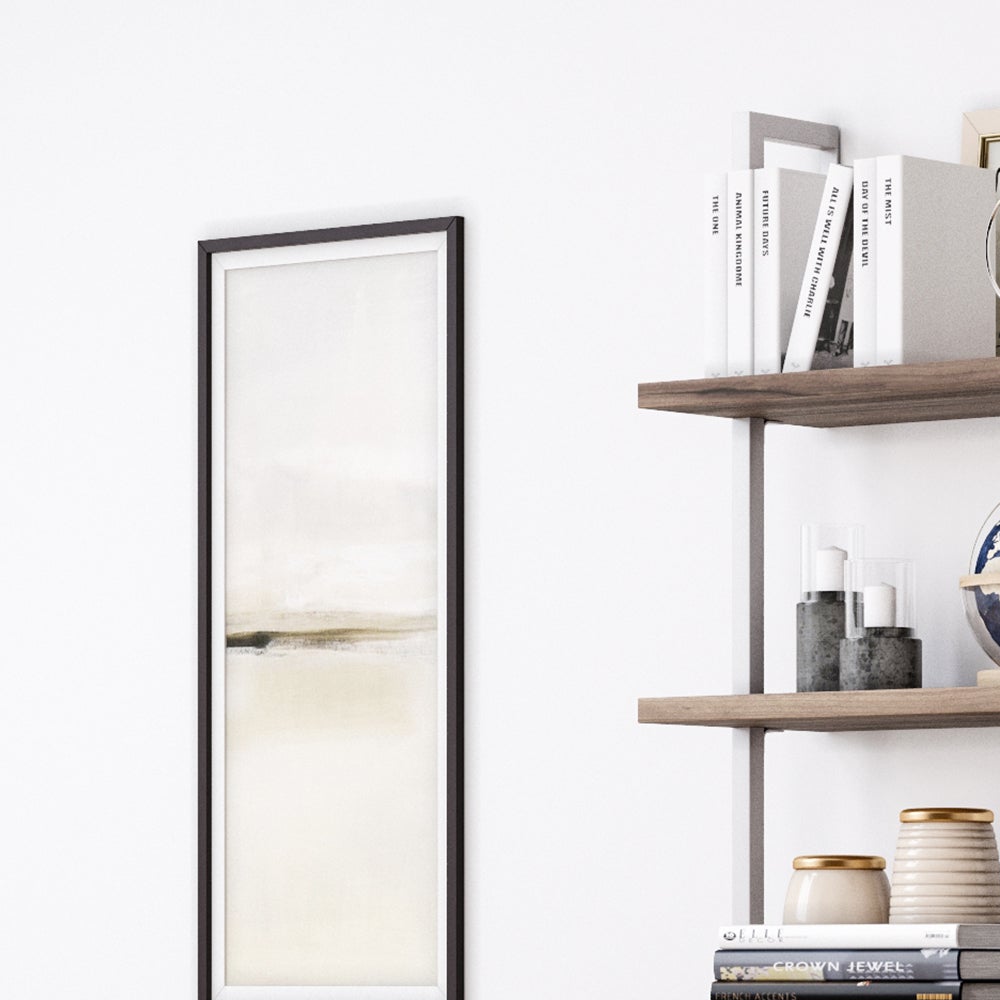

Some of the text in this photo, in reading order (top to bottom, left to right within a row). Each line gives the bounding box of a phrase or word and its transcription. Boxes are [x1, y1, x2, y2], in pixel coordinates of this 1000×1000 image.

[862, 201, 868, 215] OF
[803, 187, 840, 318] ALL IS WELL WITH CHARLIE
[773, 961, 905, 972] CROWN JEWEL
[715, 992, 797, 1000] FRENCH ACCENTS
